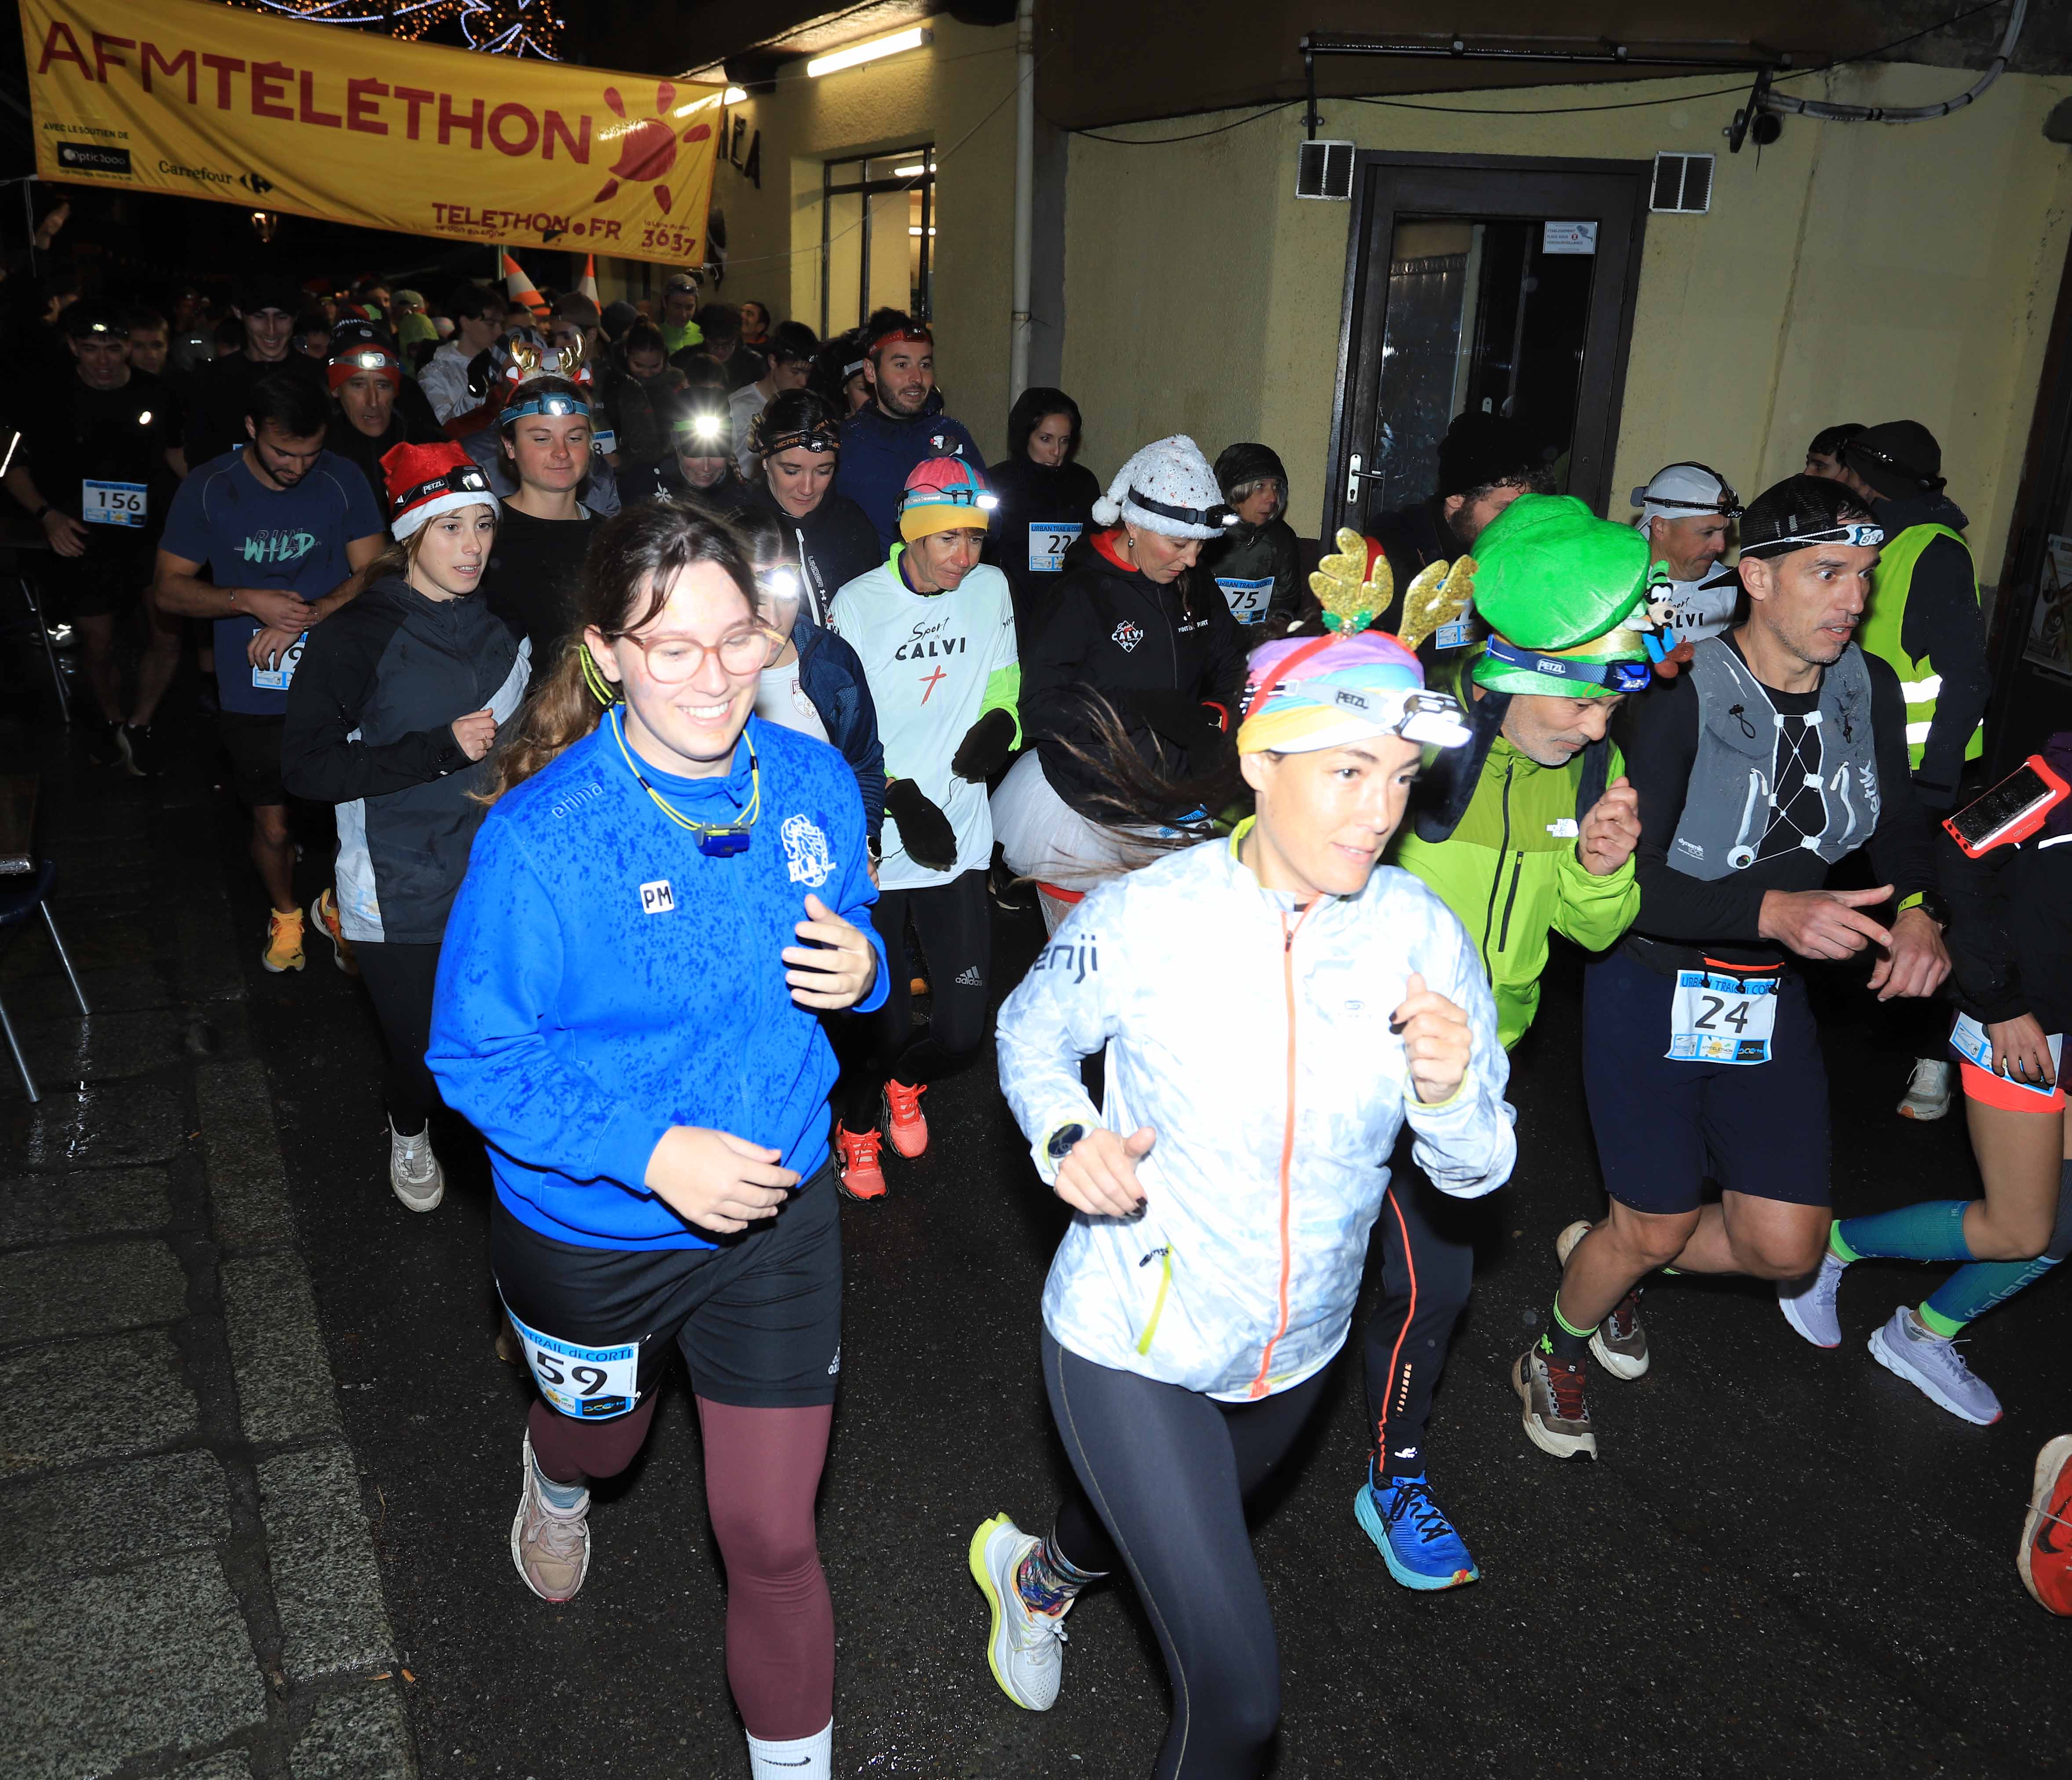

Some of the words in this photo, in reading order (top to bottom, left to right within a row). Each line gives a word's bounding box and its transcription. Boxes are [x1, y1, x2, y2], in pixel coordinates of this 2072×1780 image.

[44, 123, 65, 131] AVEC
[80, 127, 116, 138] SOUTIEN
[118, 131, 129, 139] DE
[159, 160, 233, 185] Carrefour
[641, 229, 696, 256] 3637
[422, 480, 445, 495] PETZL
[98, 491, 141, 511] 156
[244, 533, 315, 563] WILD
[808, 555, 824, 588] UNDER
[1230, 591, 1259, 609] 75
[908, 616, 950, 642] Sport
[1676, 612, 1704, 628] LVI
[1111, 629, 1143, 641] CALVI
[895, 637, 966, 661] CALVI
[1537, 660, 1566, 674] PETZL
[1336, 691, 1369, 709] PETZL
[551, 782, 604, 819] erima
[643, 886, 672, 908] PM
[1034, 934, 1098, 984] enji
[955, 977, 983, 986] adidas
[1694, 995, 1750, 1034] 24
[528, 1332, 567, 1355] TRAIL
[569, 1349, 581, 1358] di
[586, 1345, 634, 1363] CORTI
[537, 1350, 608, 1396] 59
